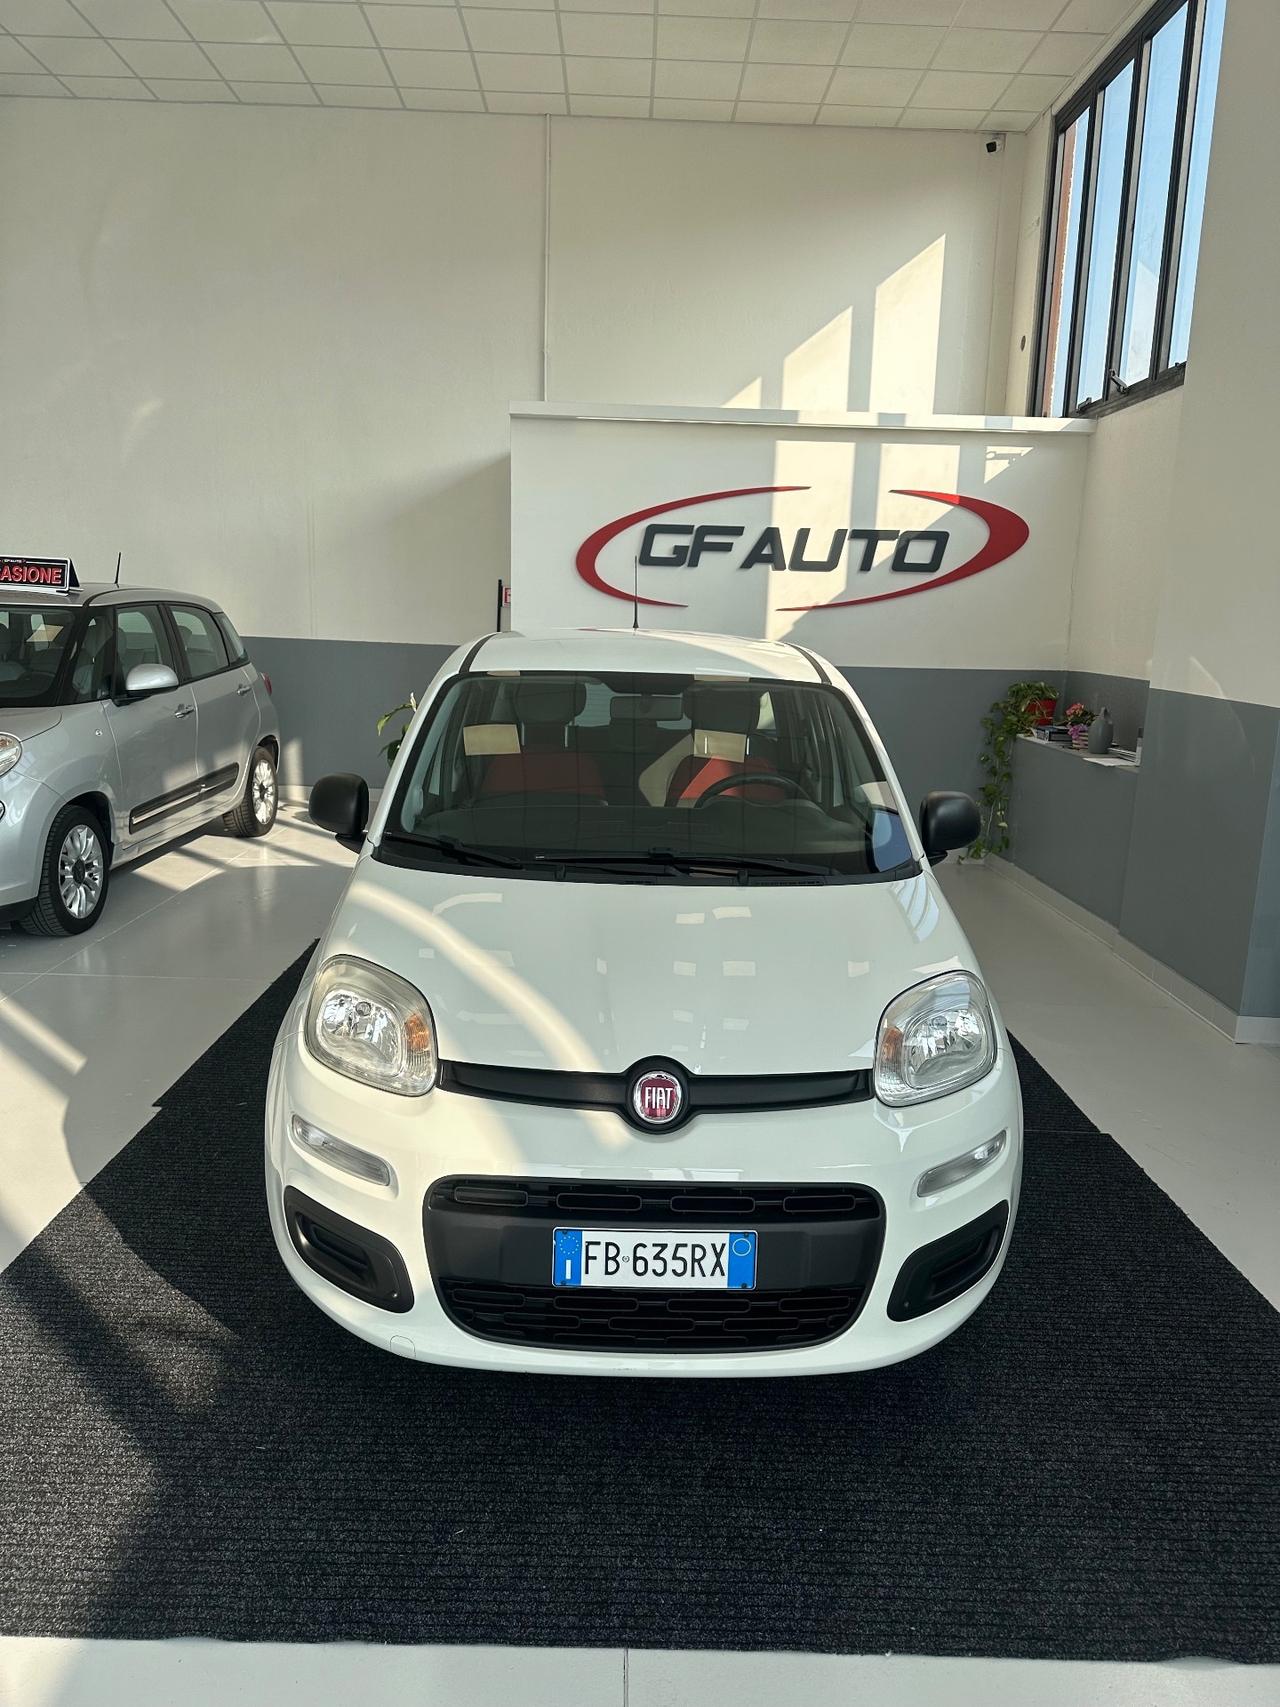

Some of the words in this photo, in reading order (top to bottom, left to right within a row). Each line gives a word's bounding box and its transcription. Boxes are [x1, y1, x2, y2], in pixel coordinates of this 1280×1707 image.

[0, 565, 62, 584] ASIONE
[645, 1087, 673, 1109] FIAT
[565, 1260, 571, 1279] I
